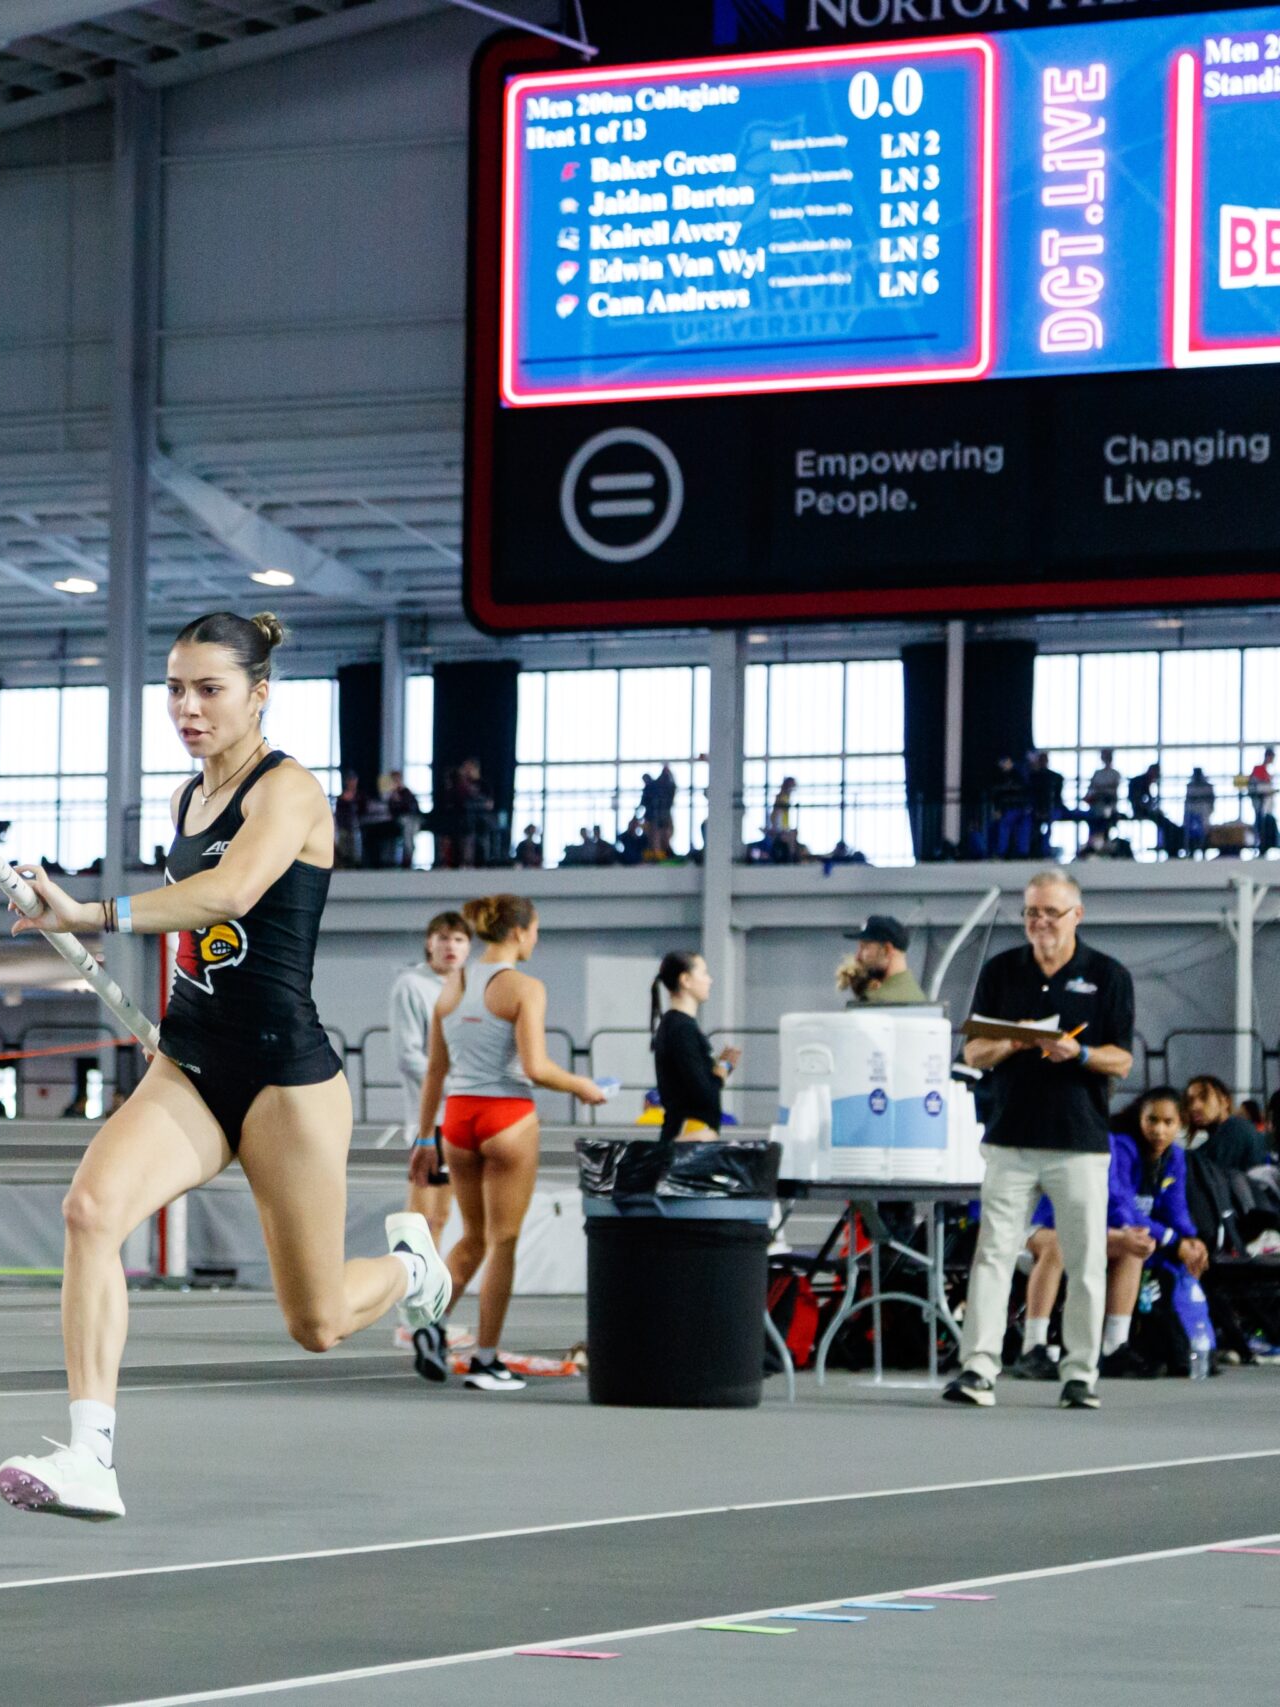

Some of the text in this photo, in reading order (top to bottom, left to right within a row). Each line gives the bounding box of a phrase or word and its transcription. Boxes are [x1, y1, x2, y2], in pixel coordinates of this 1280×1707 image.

[1207, 39, 1258, 64] Men
[526, 83, 740, 120] Men 200m Collegiate
[848, 67, 923, 119] 0.0
[526, 126, 576, 149] Heat
[595, 119, 621, 144] of
[622, 118, 647, 142] 13
[881, 130, 940, 159] LN 2
[591, 151, 736, 182] Baker Green
[881, 167, 919, 193] LN
[923, 165, 939, 190] 3
[672, 185, 754, 210] Burton
[880, 201, 919, 228] LN
[923, 200, 939, 224] 4
[590, 220, 669, 250] Kairell
[672, 219, 742, 246] Avery
[879, 236, 918, 263] LN
[922, 235, 939, 259] 5
[589, 256, 663, 284] Edwin
[667, 253, 714, 277] Van
[718, 244, 765, 279] Wyl
[879, 271, 918, 297] LN
[922, 269, 939, 294] 6
[587, 292, 644, 317] Cam
[647, 286, 750, 313] Andrews
[795, 441, 1004, 477] Empowering
[1103, 430, 1270, 466] Changing
[794, 484, 918, 518] People.
[1104, 473, 1202, 505] Lives.
